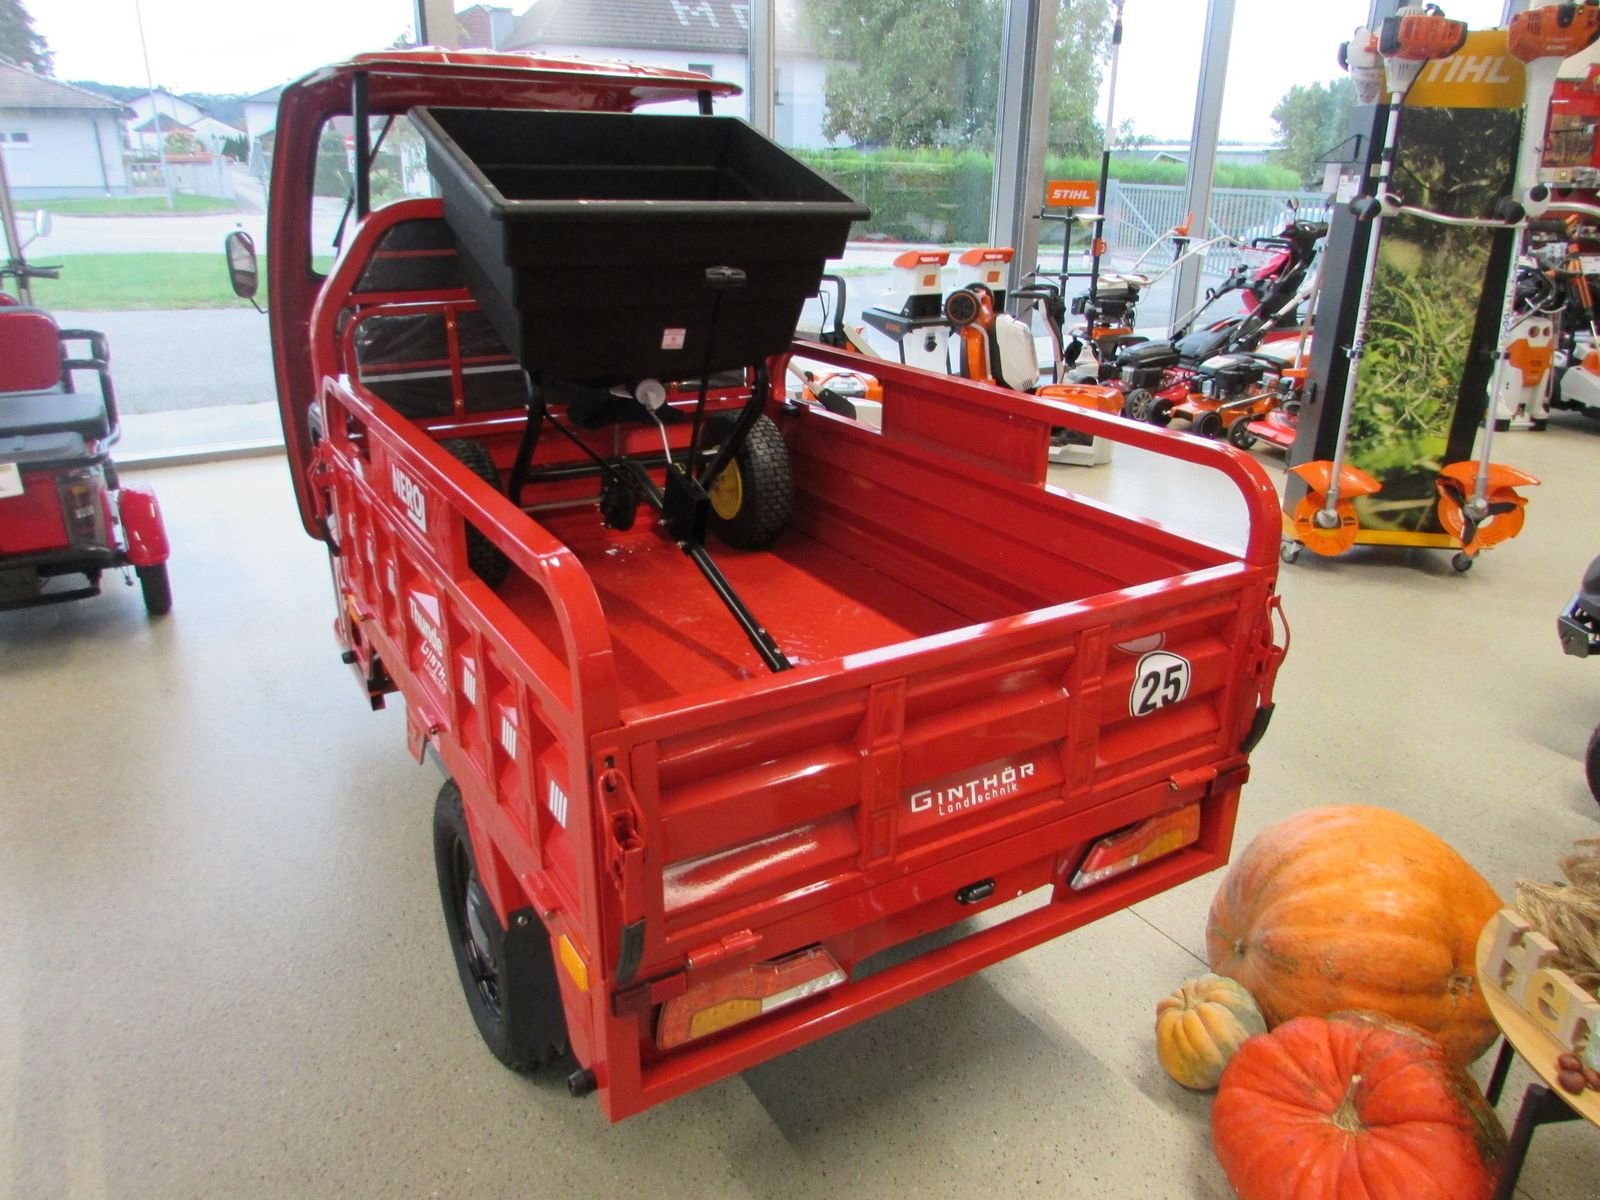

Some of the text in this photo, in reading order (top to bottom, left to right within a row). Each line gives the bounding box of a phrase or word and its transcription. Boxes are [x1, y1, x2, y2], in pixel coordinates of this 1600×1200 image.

[1415, 55, 1510, 83] TIHL
[1052, 189, 1090, 200] STIHL
[1137, 664, 1183, 714] 25
[911, 763, 1035, 813] GINTHÖR
